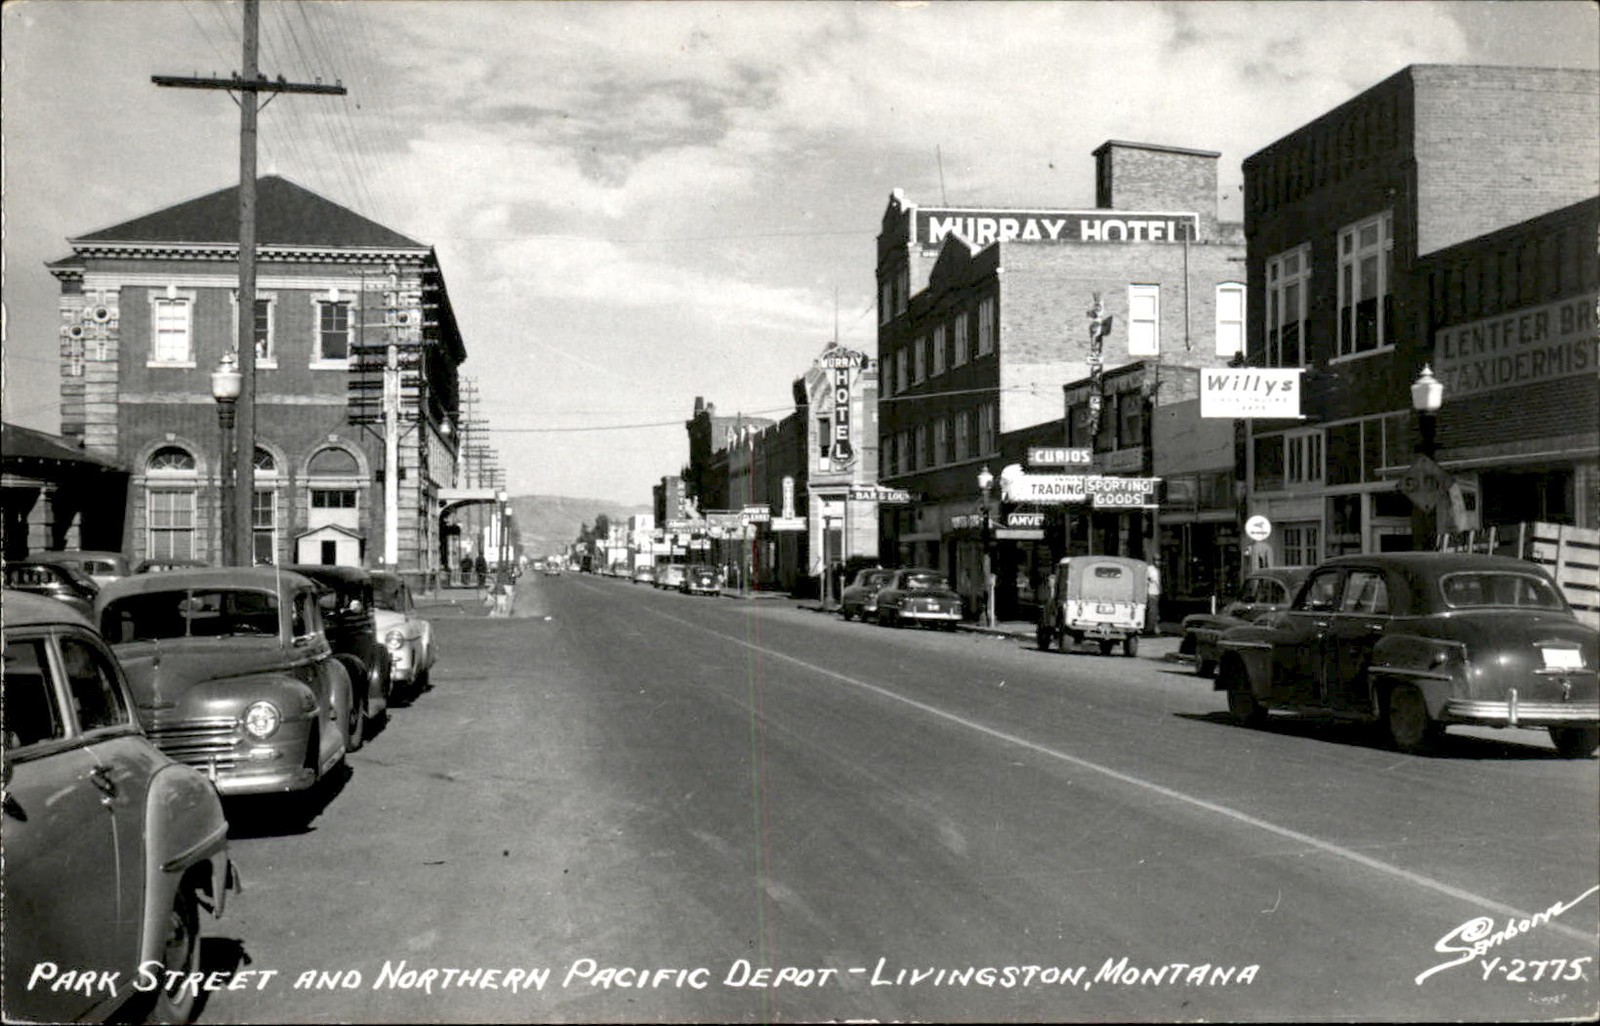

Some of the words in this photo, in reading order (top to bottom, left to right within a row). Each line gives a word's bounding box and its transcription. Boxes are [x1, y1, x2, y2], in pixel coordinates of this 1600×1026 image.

[928, 216, 1066, 244] MURRAY
[1442, 309, 1550, 361] LENTFER
[820, 357, 863, 368] MURRAY
[1207, 374, 1294, 397] Willys
[835, 368, 849, 459] HOTEL
[1034, 449, 1091, 463] CURIOS
[1031, 483, 1082, 495] TRADING
[1087, 479, 1151, 492] SPORTING
[855, 490, 877, 500] BAR
[1095, 493, 1143, 505] GOODS
